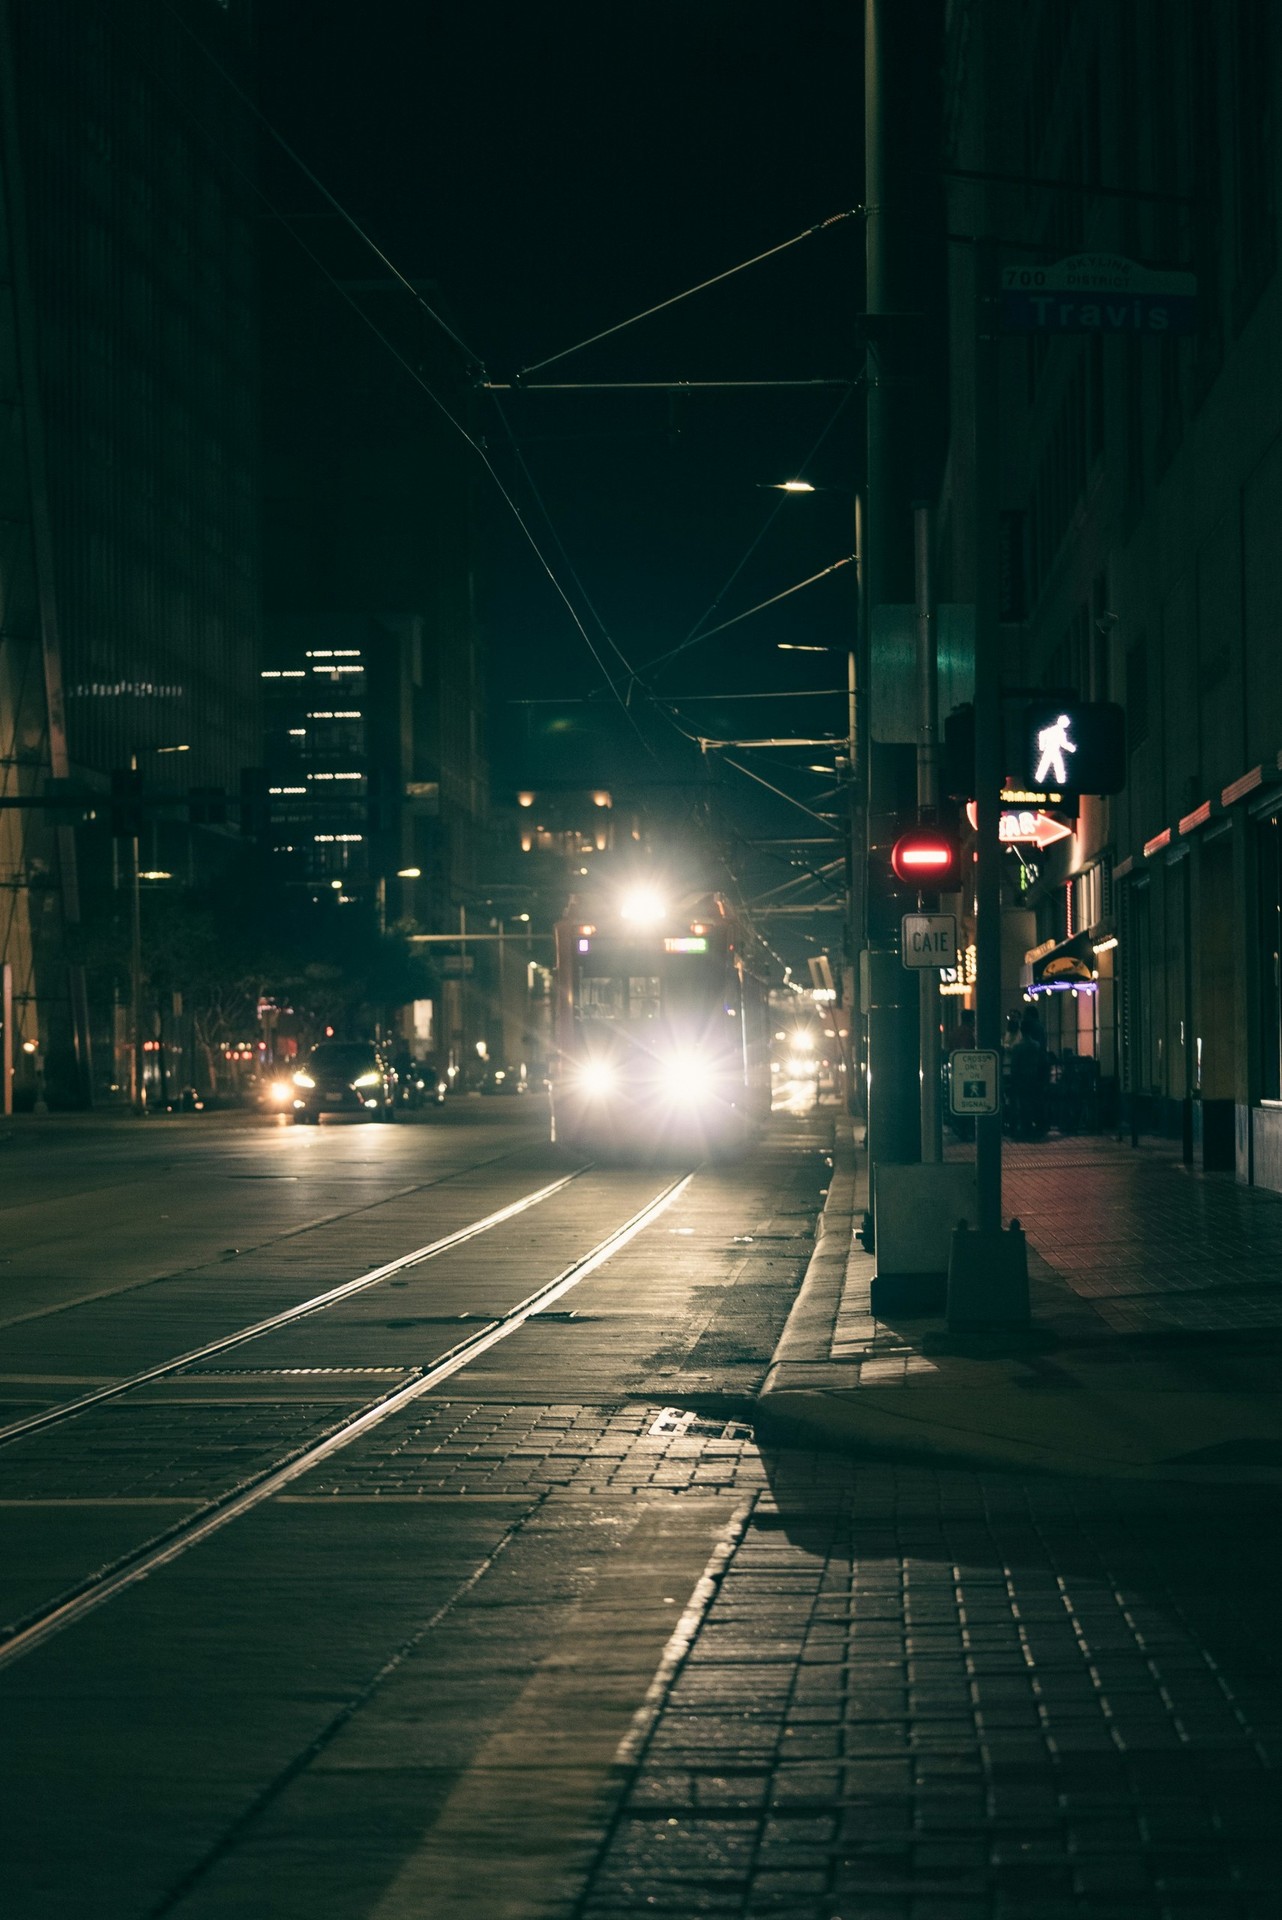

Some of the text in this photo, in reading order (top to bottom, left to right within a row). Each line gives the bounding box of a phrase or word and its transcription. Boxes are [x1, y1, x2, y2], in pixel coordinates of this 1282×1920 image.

[1007, 271, 1046, 287] 700
[1067, 274, 1131, 288] DISTRICT
[1029, 296, 1169, 330] Travis
